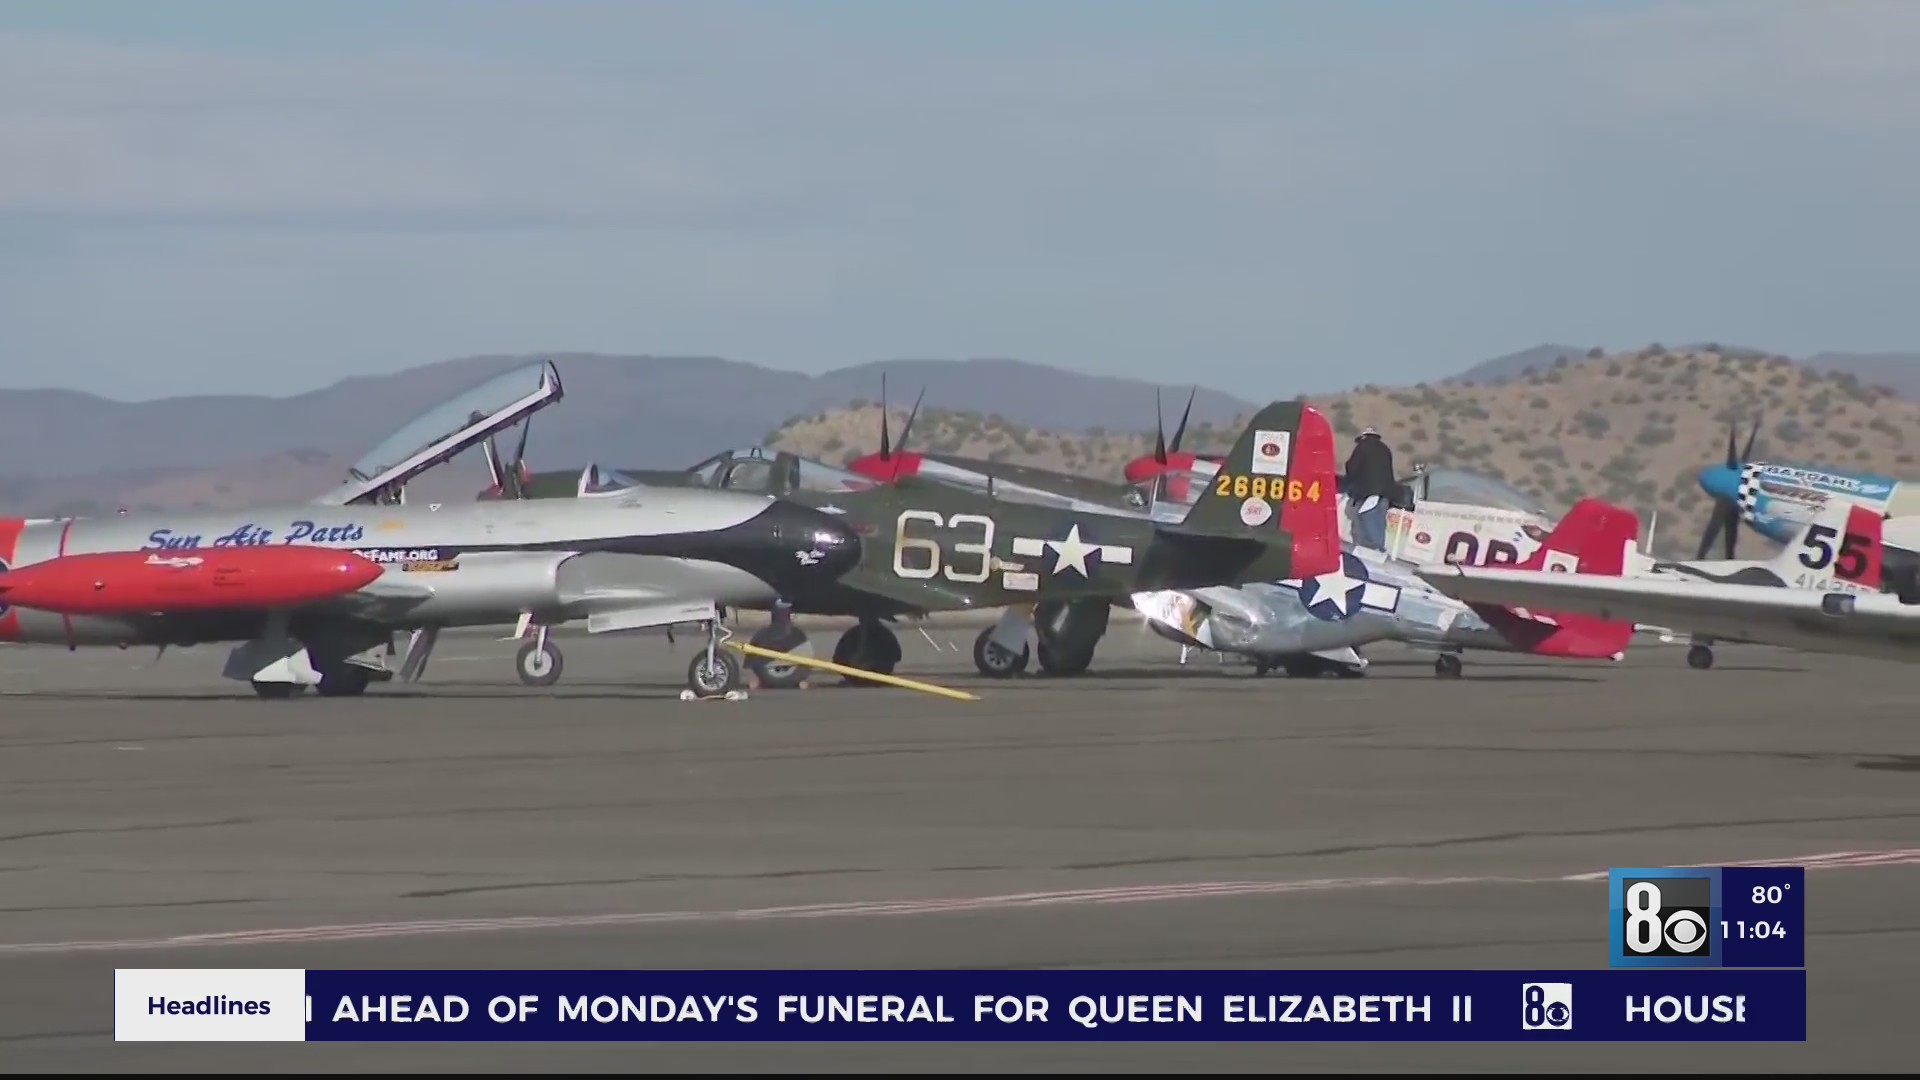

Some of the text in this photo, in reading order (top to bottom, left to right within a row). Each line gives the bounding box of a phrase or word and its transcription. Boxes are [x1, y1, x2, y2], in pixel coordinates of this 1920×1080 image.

[1216, 475, 1321, 502] 268864
[142, 529, 202, 550] Sun
[213, 524, 273, 547] Air
[285, 521, 364, 545] Parts
[893, 510, 995, 583] 63
